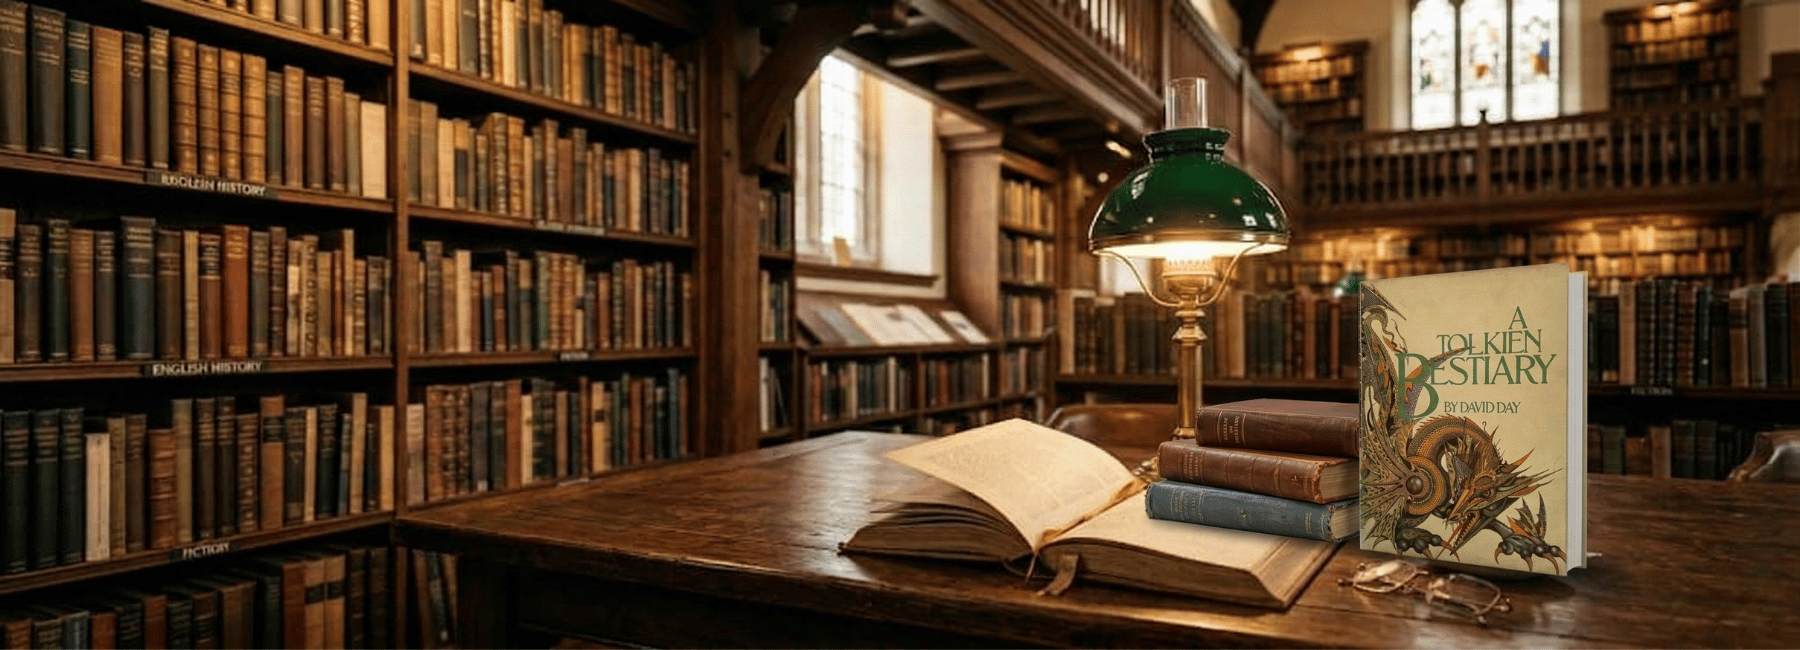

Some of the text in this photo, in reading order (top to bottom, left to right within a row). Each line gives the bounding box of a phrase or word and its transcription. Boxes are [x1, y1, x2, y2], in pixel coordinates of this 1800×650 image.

[217, 181, 266, 196] HISTORY
[1508, 306, 1528, 330] A
[1436, 329, 1542, 356] TOLKIEN
[152, 361, 262, 376] ENGLISH HISTORY
[1395, 353, 1557, 420] BESTIARY
[1444, 401, 1521, 414] BY DAVID DAY
